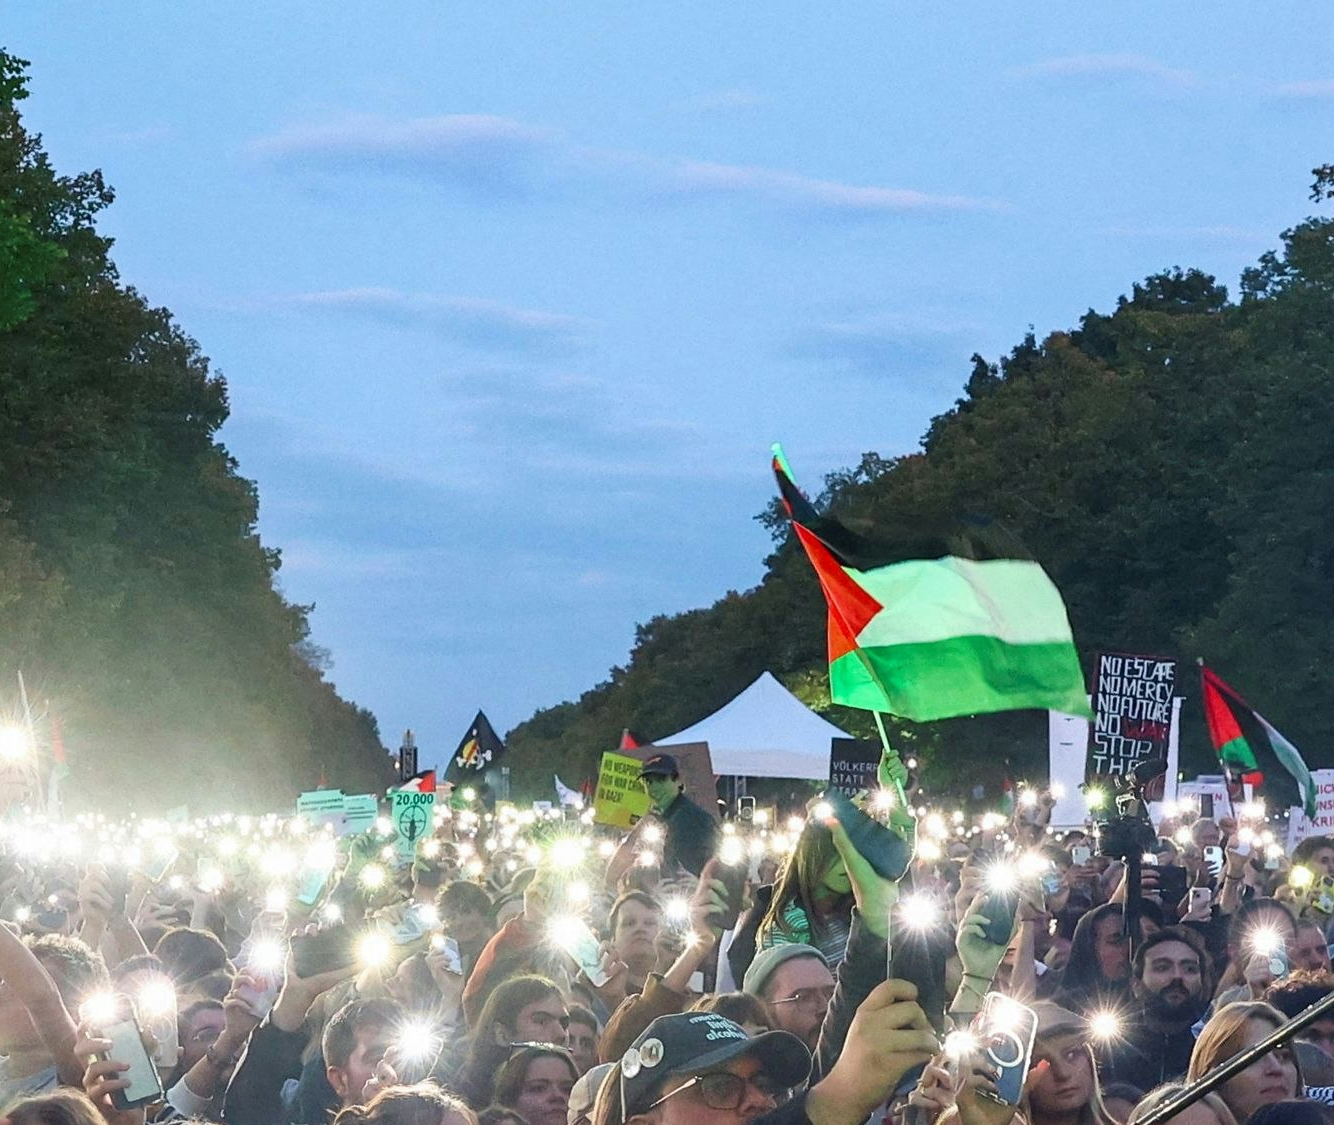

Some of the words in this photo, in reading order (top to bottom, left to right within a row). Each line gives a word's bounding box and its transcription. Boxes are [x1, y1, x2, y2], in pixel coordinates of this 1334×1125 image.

[1100, 655, 1122, 676] NO
[1124, 658, 1175, 681] ESCAPE
[1098, 675, 1119, 694] NO
[1122, 677, 1174, 703] MERCY
[1097, 693, 1119, 715] NO
[1120, 696, 1171, 724] FUTURE
[1094, 712, 1121, 736] NO
[1093, 732, 1153, 758] STOP
[396, 793, 434, 806] 20.000
